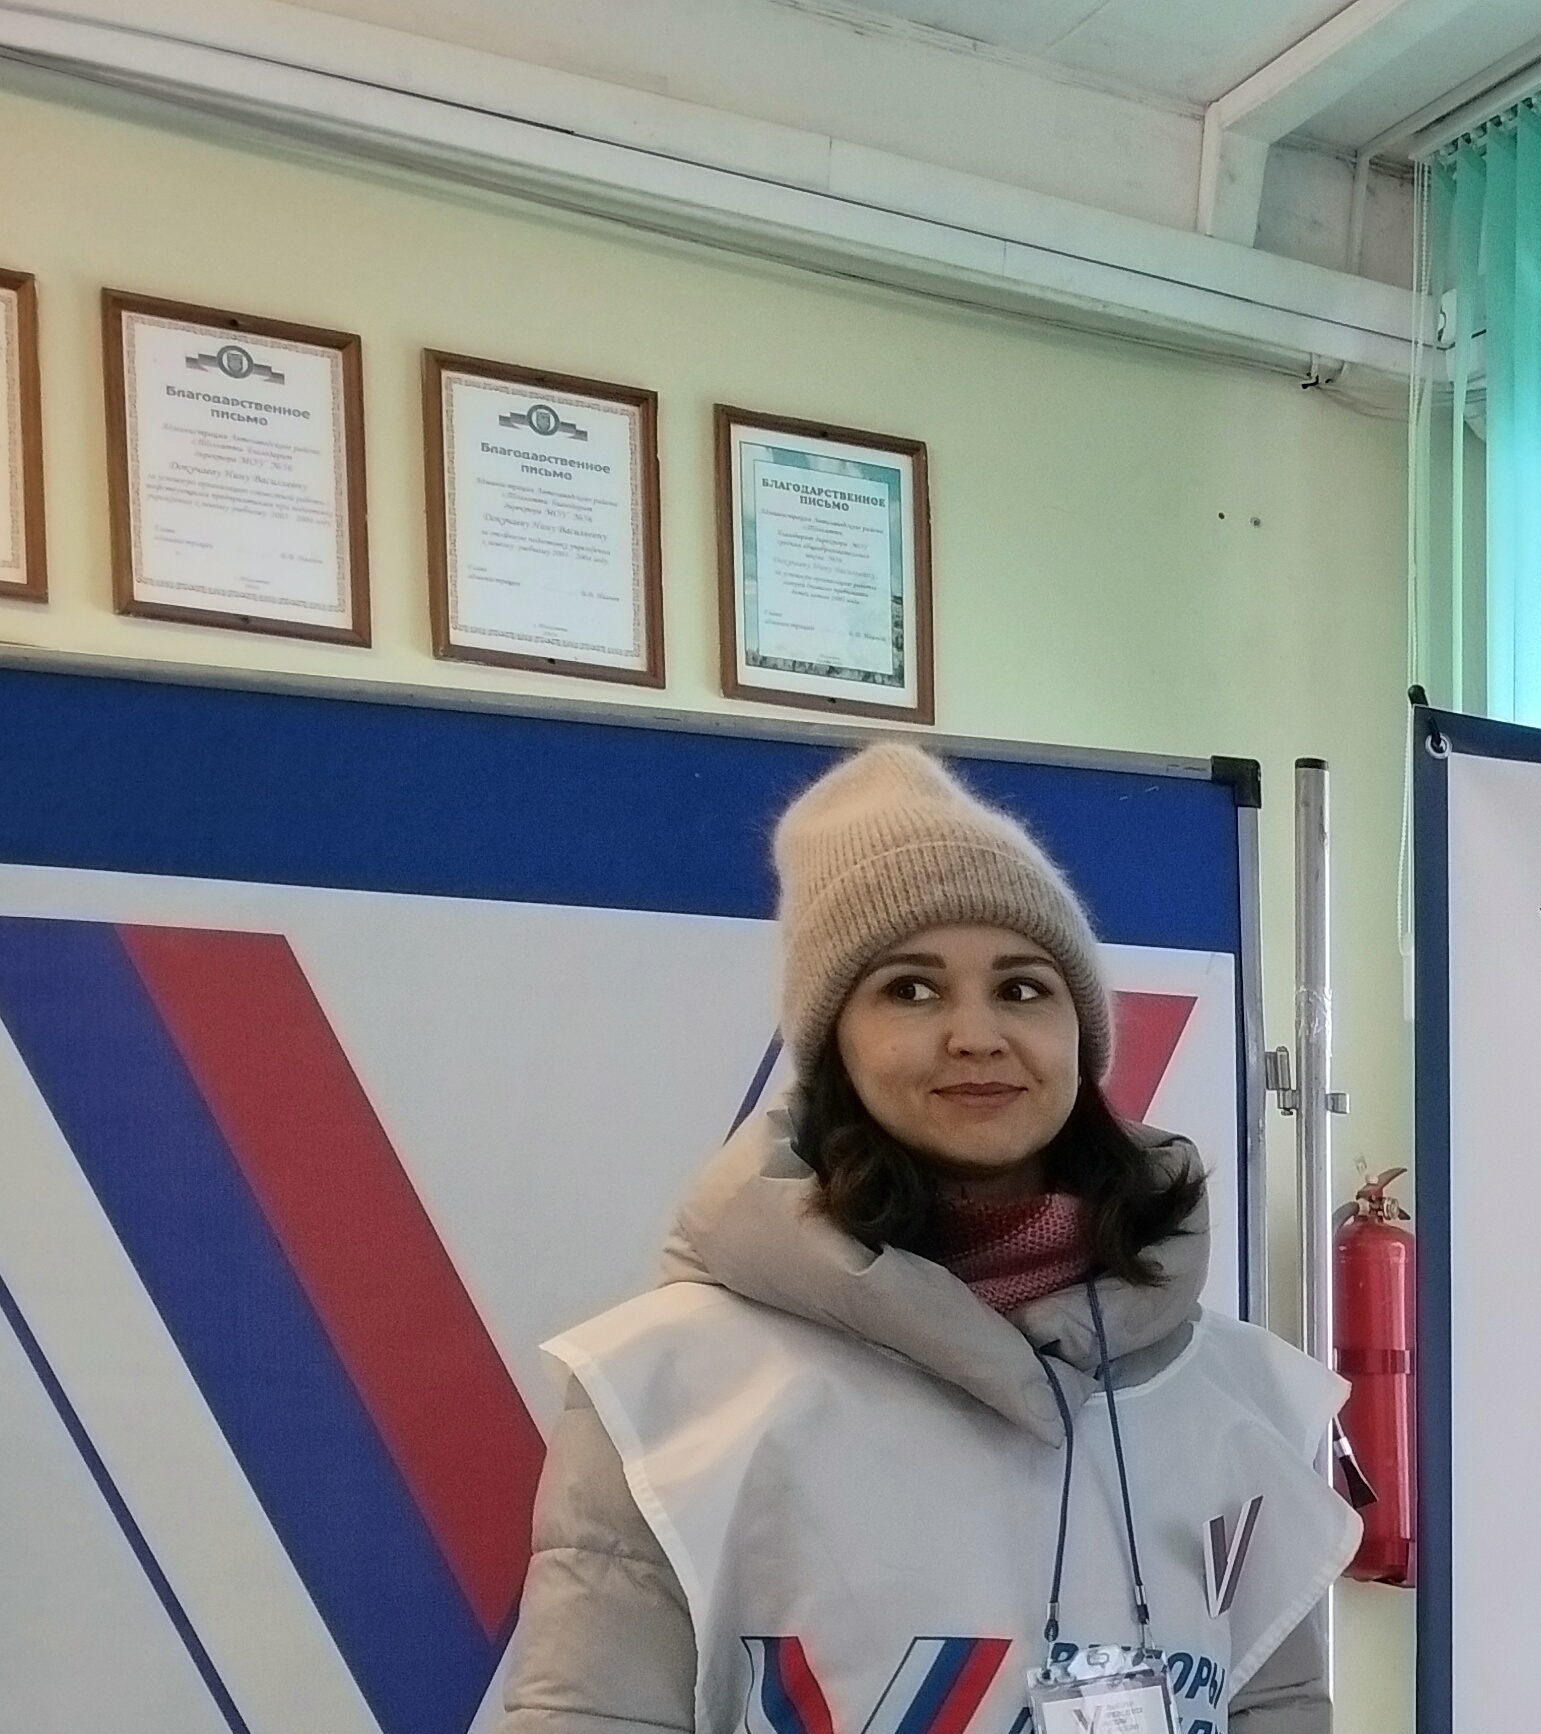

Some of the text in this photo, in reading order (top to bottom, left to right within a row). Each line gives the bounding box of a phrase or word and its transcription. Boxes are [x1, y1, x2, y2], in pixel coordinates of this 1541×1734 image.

[166, 385, 310, 419] Благодарственное
[211, 408, 268, 426] письмо
[480, 442, 611, 474] Благодарственное
[521, 464, 572, 481] письмо
[762, 478, 886, 507] БЛАГОДАРСТВЕННОЕ
[800, 495, 849, 512] ПИСЬМО
